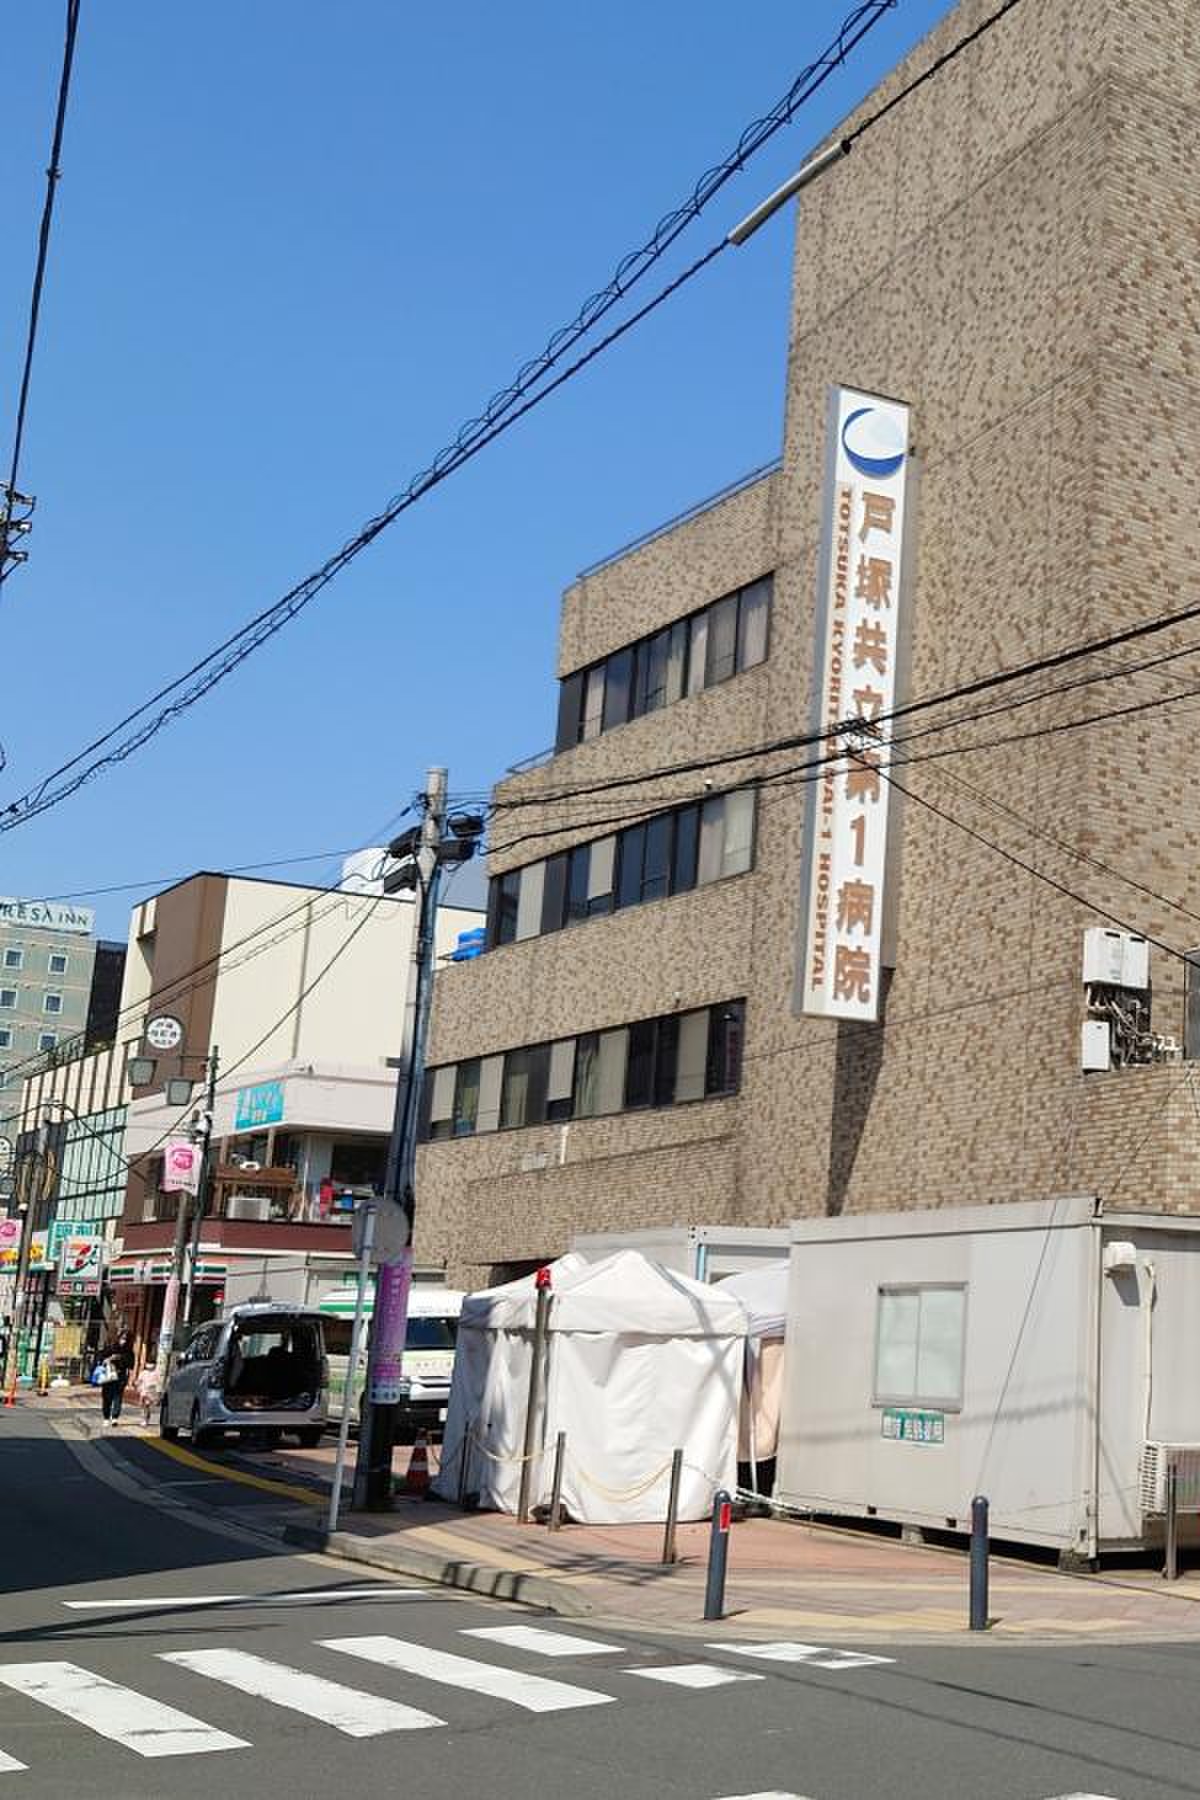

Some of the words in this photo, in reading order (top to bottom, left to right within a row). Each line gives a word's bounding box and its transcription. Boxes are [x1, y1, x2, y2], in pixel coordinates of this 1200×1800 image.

[834, 489, 851, 609] TOTSUKA
[834, 491, 895, 1003] 戸塚共立第1病院
[59, 911, 89, 927] INN
[812, 852, 831, 987] HOSPITAL
